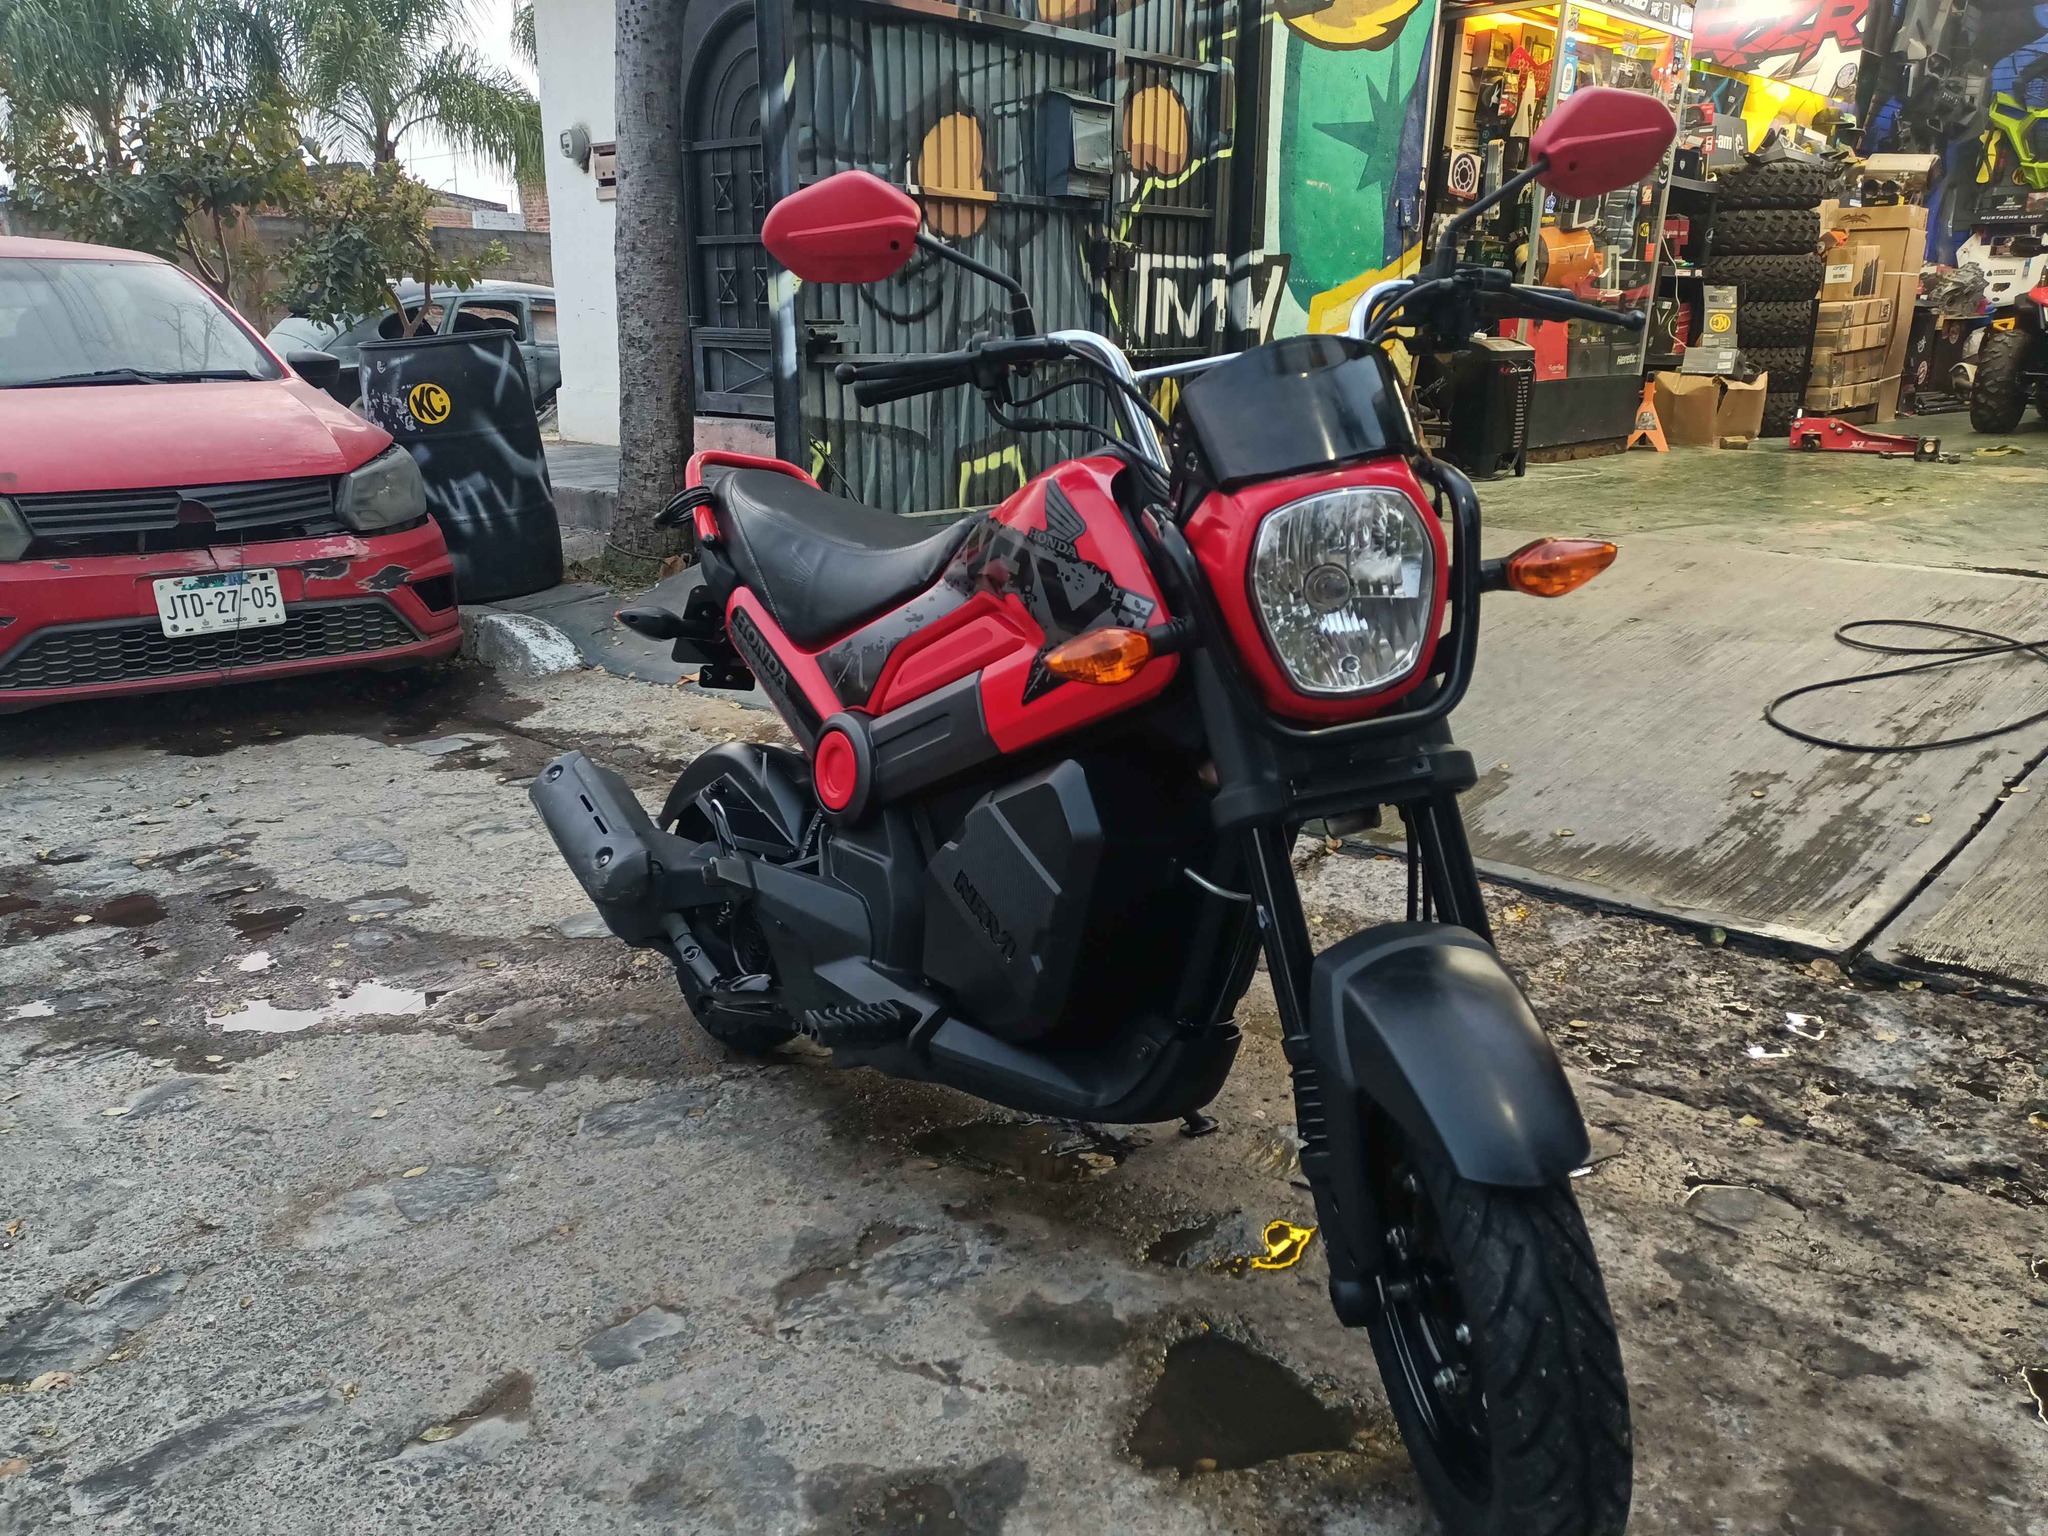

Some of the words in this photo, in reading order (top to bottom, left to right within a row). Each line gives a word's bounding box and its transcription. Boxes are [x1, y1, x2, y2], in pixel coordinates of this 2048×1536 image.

[1712, 315, 1728, 330] KC
[1616, 352, 1637, 365] Heretic
[411, 386, 447, 421] KC
[1028, 526, 1077, 557] HONDA
[166, 585, 277, 621] JTD-27-05
[736, 609, 788, 695] HONDA
[953, 869, 1017, 960] NAVI
